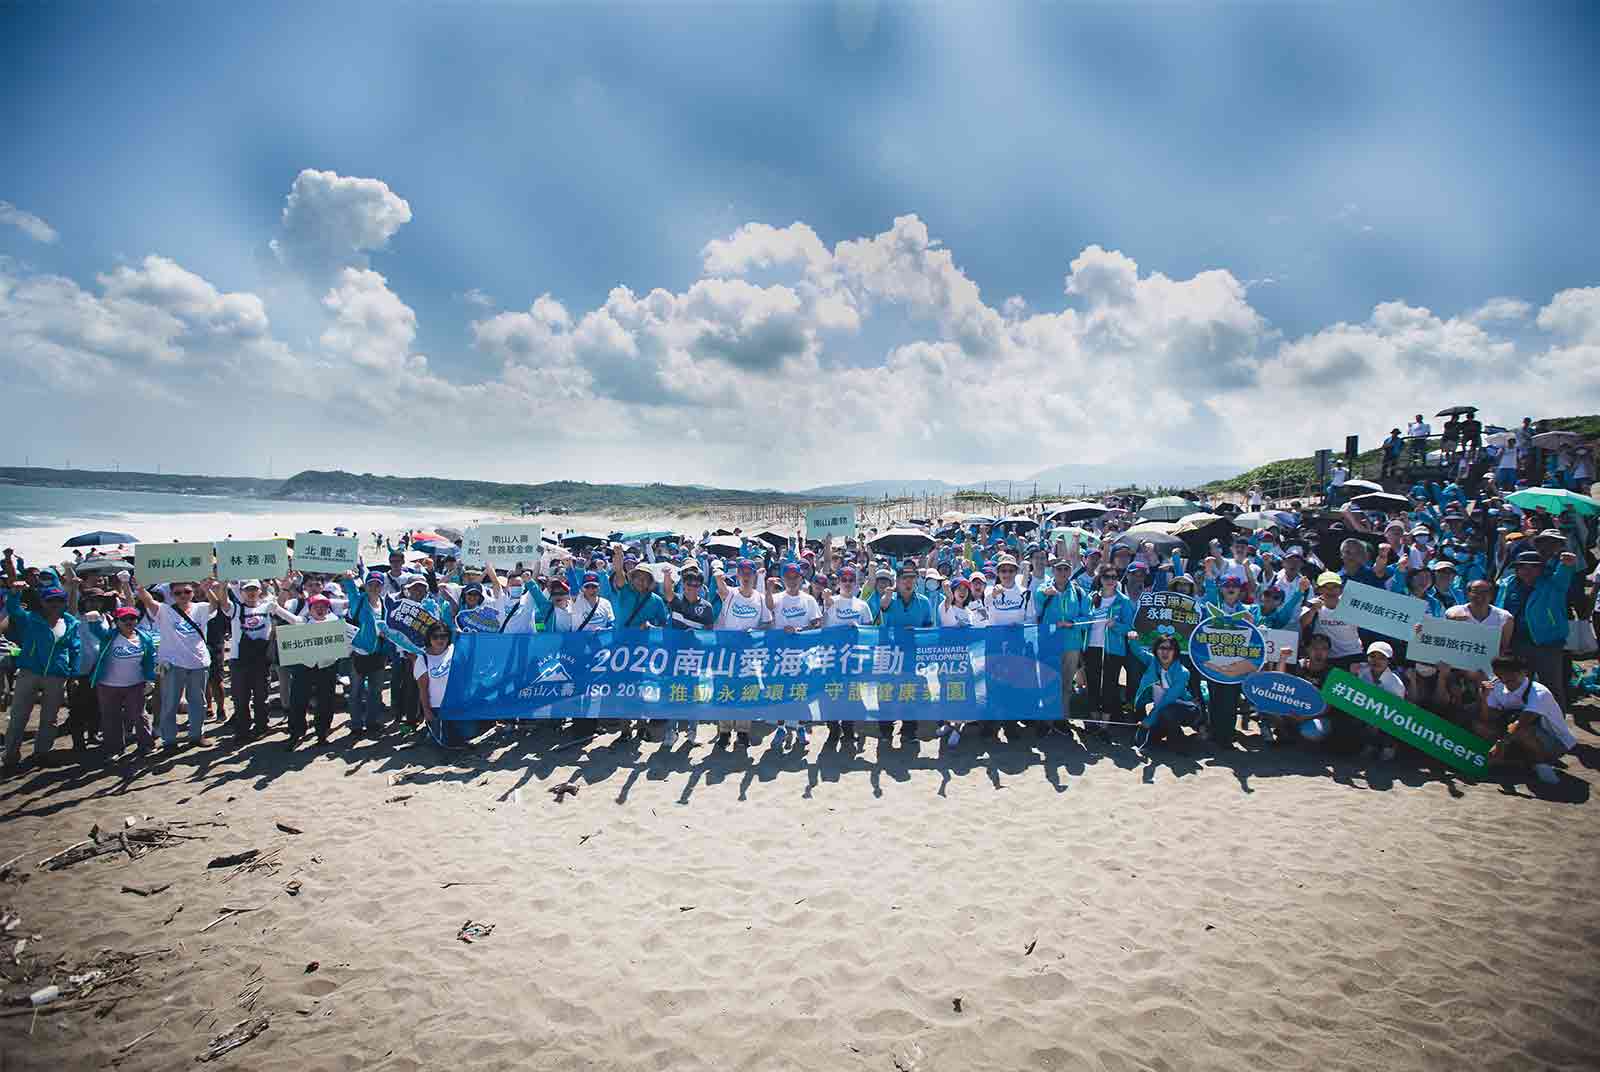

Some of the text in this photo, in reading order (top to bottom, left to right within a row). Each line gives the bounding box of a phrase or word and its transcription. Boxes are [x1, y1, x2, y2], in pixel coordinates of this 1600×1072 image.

[230, 554, 277, 566] 林務局
[1350, 598, 1411, 624] 東南旅行社
[518, 683, 576, 698] 南山人壽
[585, 683, 612, 697] ISO
[1271, 682, 1296, 695] IBM
[1251, 685, 1312, 710] Volunteers
[1332, 681, 1486, 767] #IBMVolunteers
